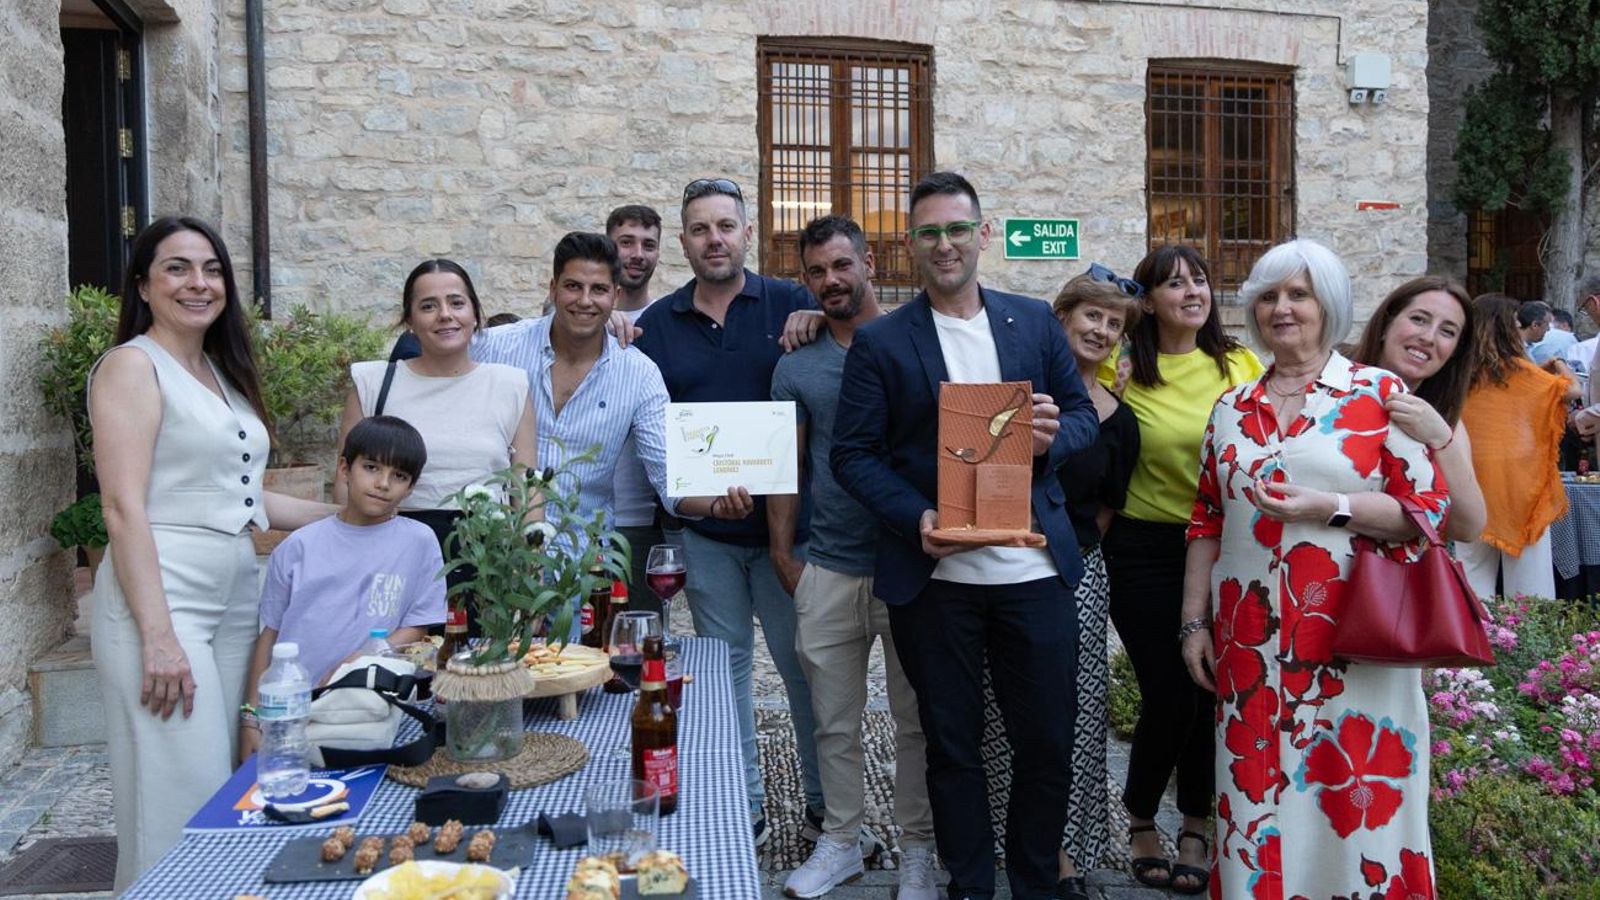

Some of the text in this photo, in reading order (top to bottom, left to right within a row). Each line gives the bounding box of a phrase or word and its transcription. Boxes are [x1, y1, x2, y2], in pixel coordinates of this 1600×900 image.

[1033, 223, 1075, 238] SALIDA
[1041, 240, 1067, 255] EXIT
[371, 573, 407, 592] FUN
[366, 601, 401, 617] SUN
